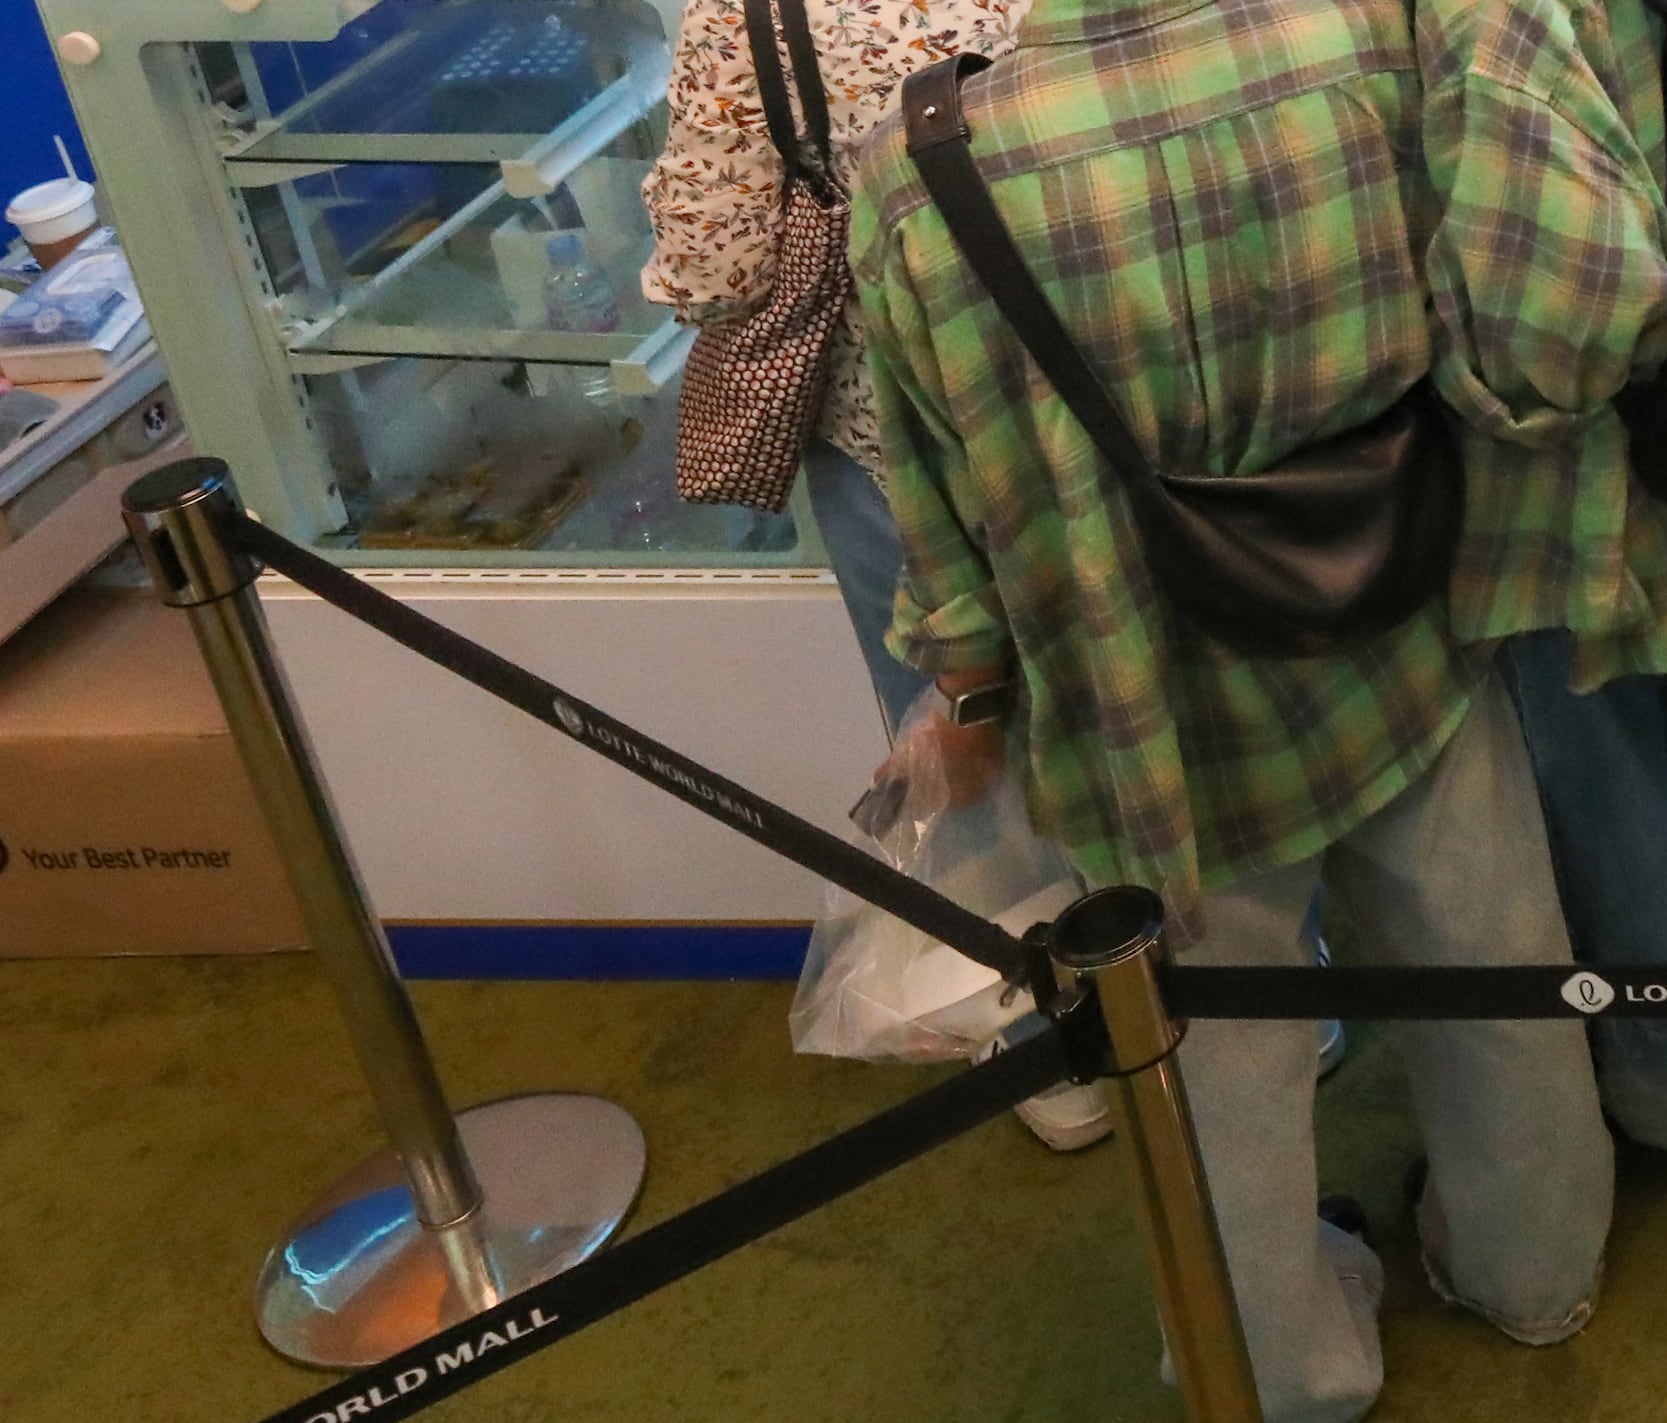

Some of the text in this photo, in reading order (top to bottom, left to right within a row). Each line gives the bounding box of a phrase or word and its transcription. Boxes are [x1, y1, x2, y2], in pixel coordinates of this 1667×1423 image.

[587, 721, 763, 828] LOTTE WORLD MALL
[21, 847, 232, 870] Your Best Partner
[435, 1306, 560, 1376] MALL
